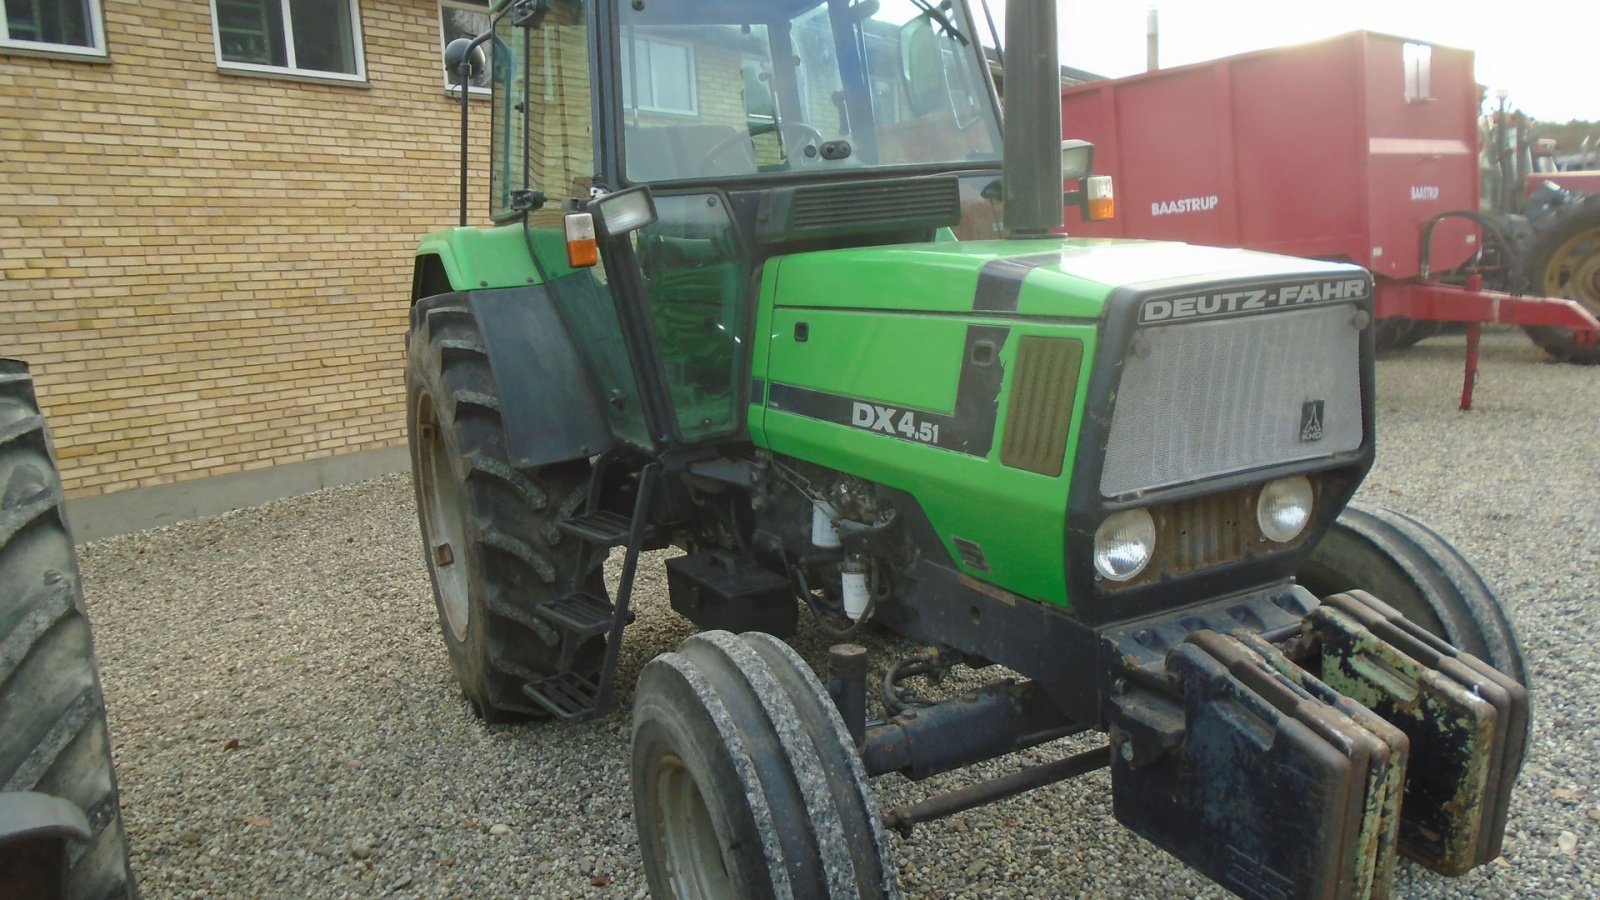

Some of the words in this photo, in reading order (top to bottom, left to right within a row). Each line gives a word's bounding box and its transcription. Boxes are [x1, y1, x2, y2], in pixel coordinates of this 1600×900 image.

[1411, 186, 1439, 200] BAASTRUP
[1151, 196, 1219, 216] BAASTRUP
[1144, 279, 1366, 321] DEUTZ-FAHR
